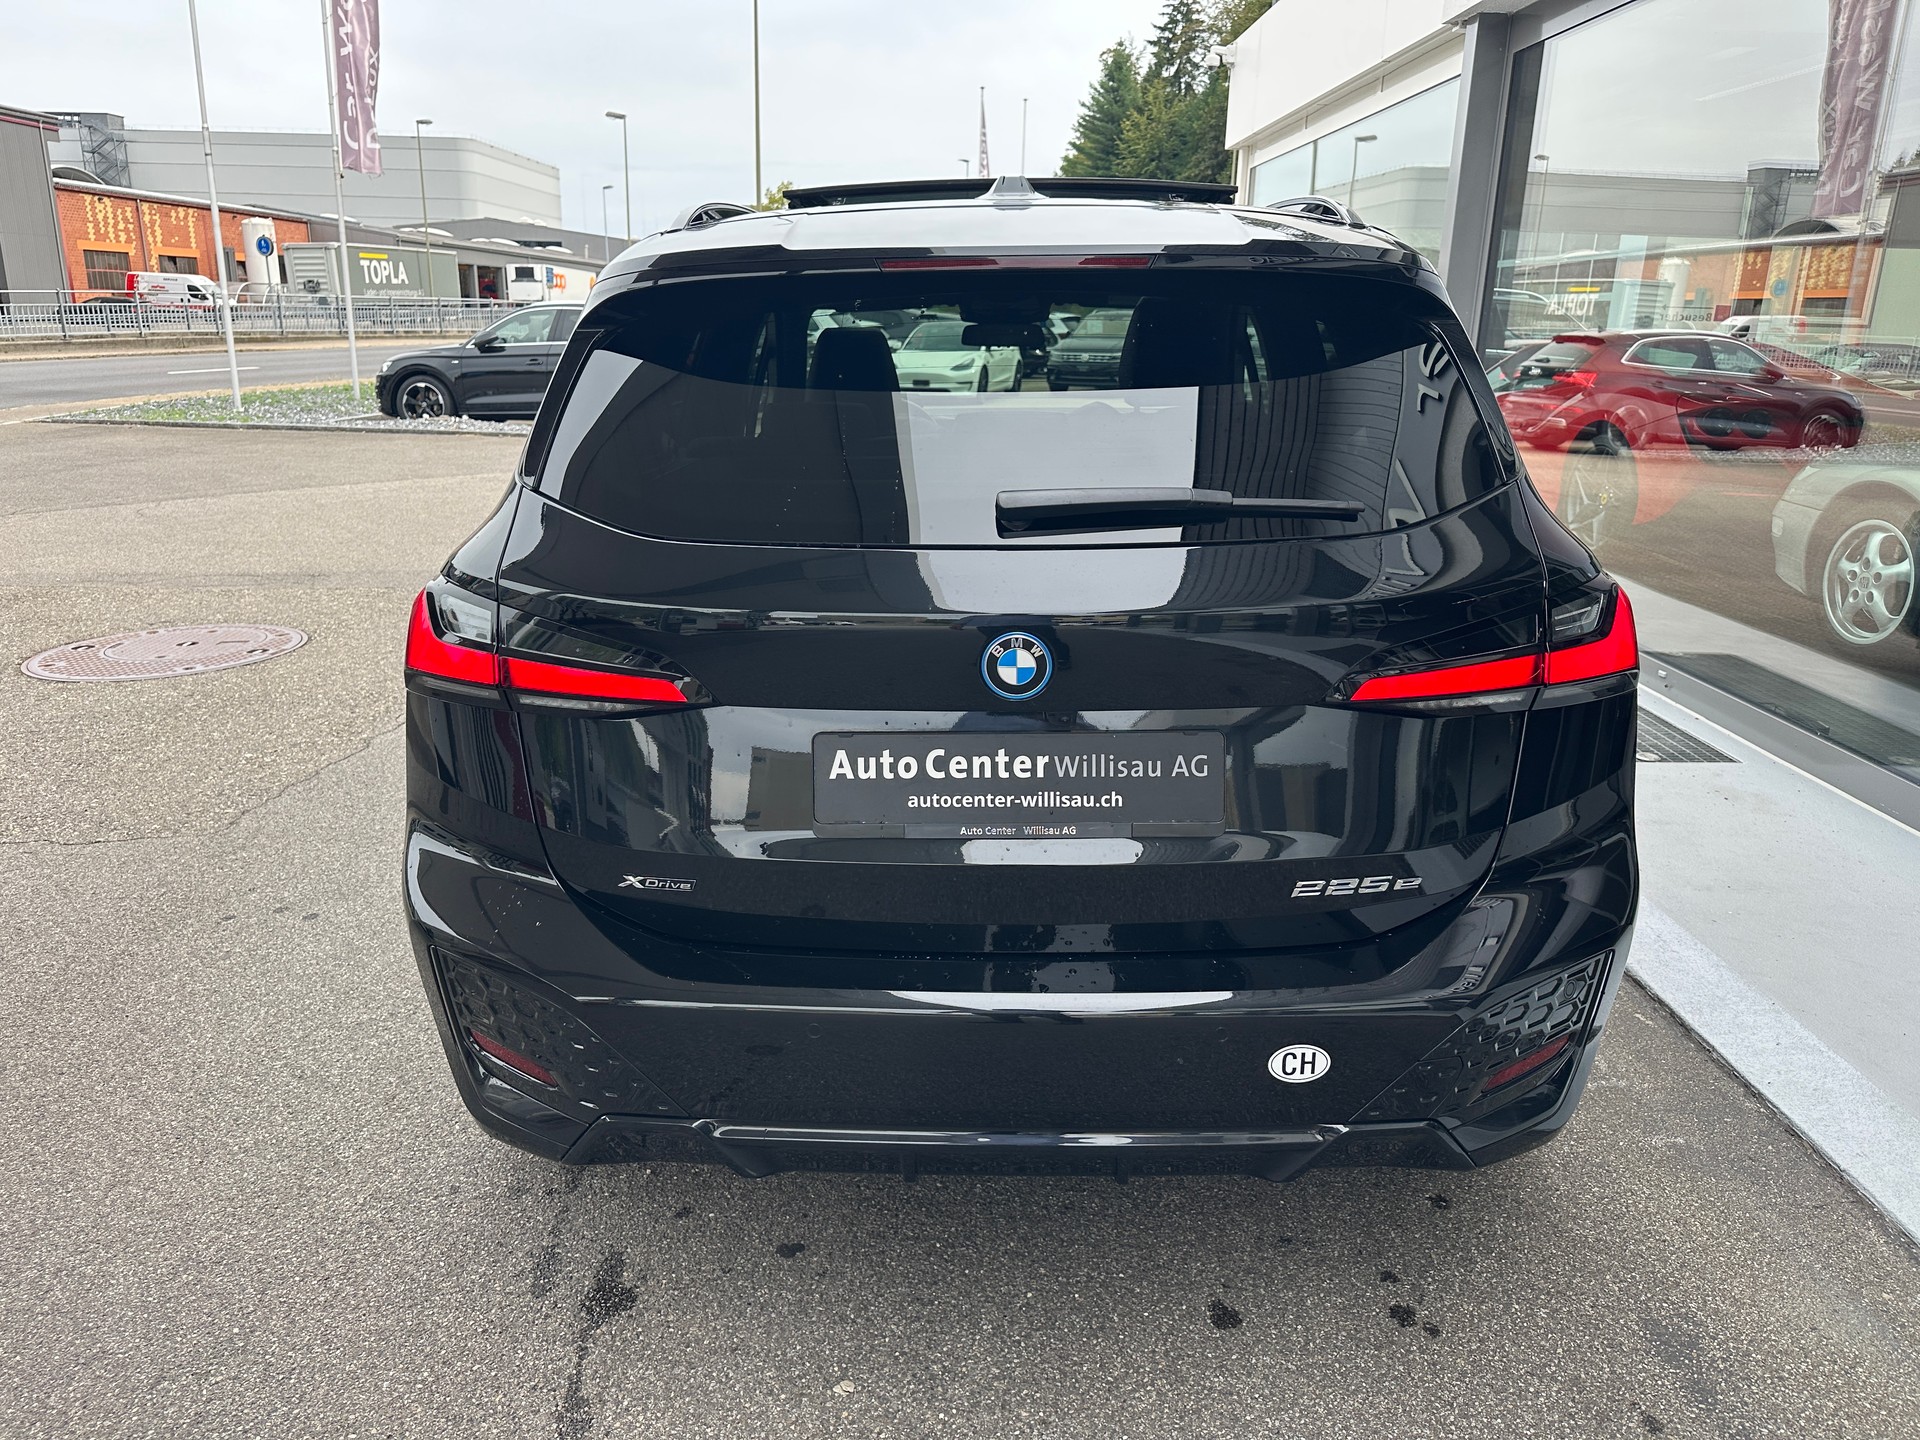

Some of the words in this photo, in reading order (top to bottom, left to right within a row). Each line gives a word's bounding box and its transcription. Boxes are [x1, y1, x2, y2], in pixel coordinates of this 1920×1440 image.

[359, 259, 409, 285] TOPLA
[991, 637, 1044, 658] BMW
[828, 749, 919, 780] Auto
[925, 748, 1049, 779] Center
[1053, 753, 1162, 778] Willisau
[1171, 754, 1209, 778] AG
[907, 791, 1124, 808] autocenter-willisau.ch
[960, 826, 983, 836] Auto
[985, 826, 1017, 836] Center
[1023, 826, 1060, 836] Willisau
[1062, 826, 1077, 836] AG
[1290, 875, 1423, 898] 225e
[1282, 1052, 1317, 1076] CH
